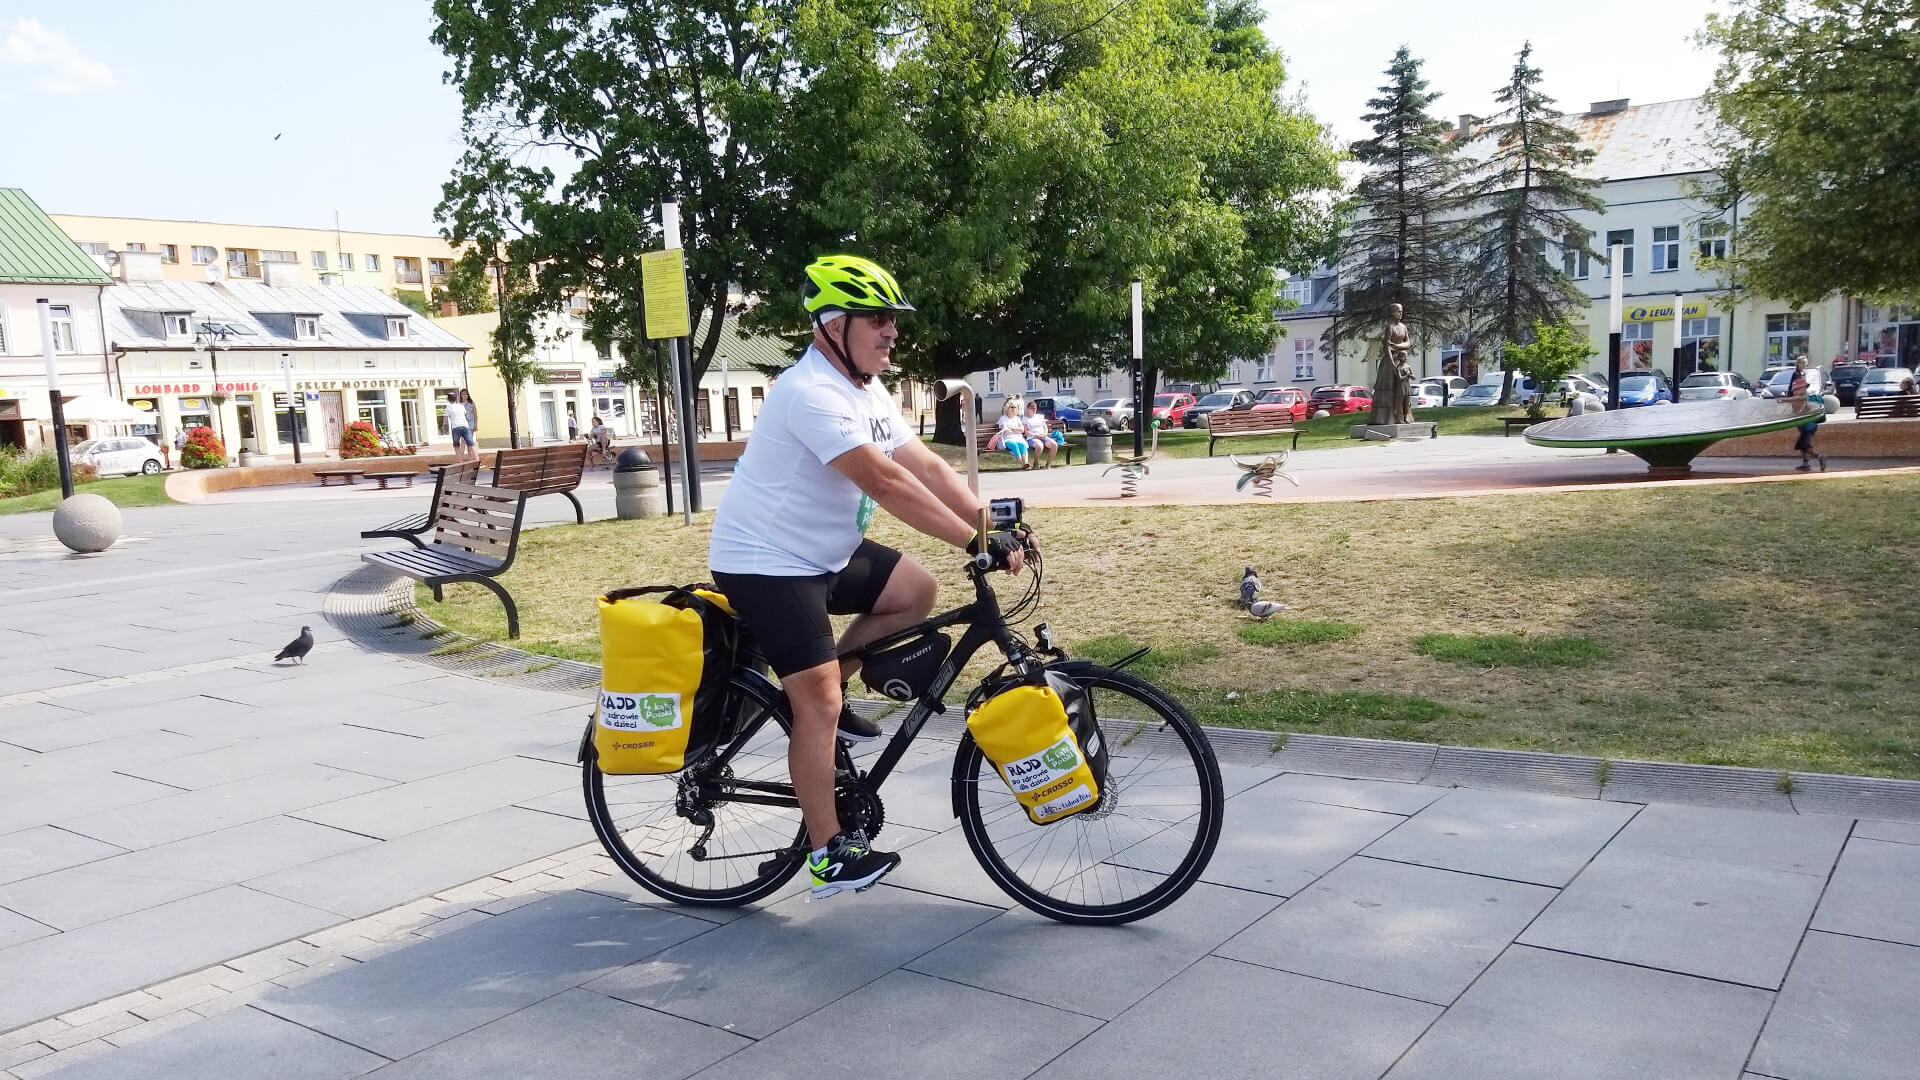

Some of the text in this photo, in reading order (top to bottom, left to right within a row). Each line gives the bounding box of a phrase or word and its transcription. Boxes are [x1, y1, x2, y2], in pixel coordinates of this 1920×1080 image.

[1649, 306, 1699, 318] LEWITAN
[135, 382, 259, 394] LOMBARD KOMIS
[296, 379, 443, 390] SKLEP MOTORYZACYJNY
[607, 712, 639, 720] zdrowie
[613, 720, 637, 729] dzieci
[622, 741, 655, 750] CROSSO
[1007, 759, 1042, 776] RAJD
[1022, 769, 1048, 783] zdrowie
[1030, 775, 1050, 788] dzieci
[1041, 777, 1074, 797] CROSSO
